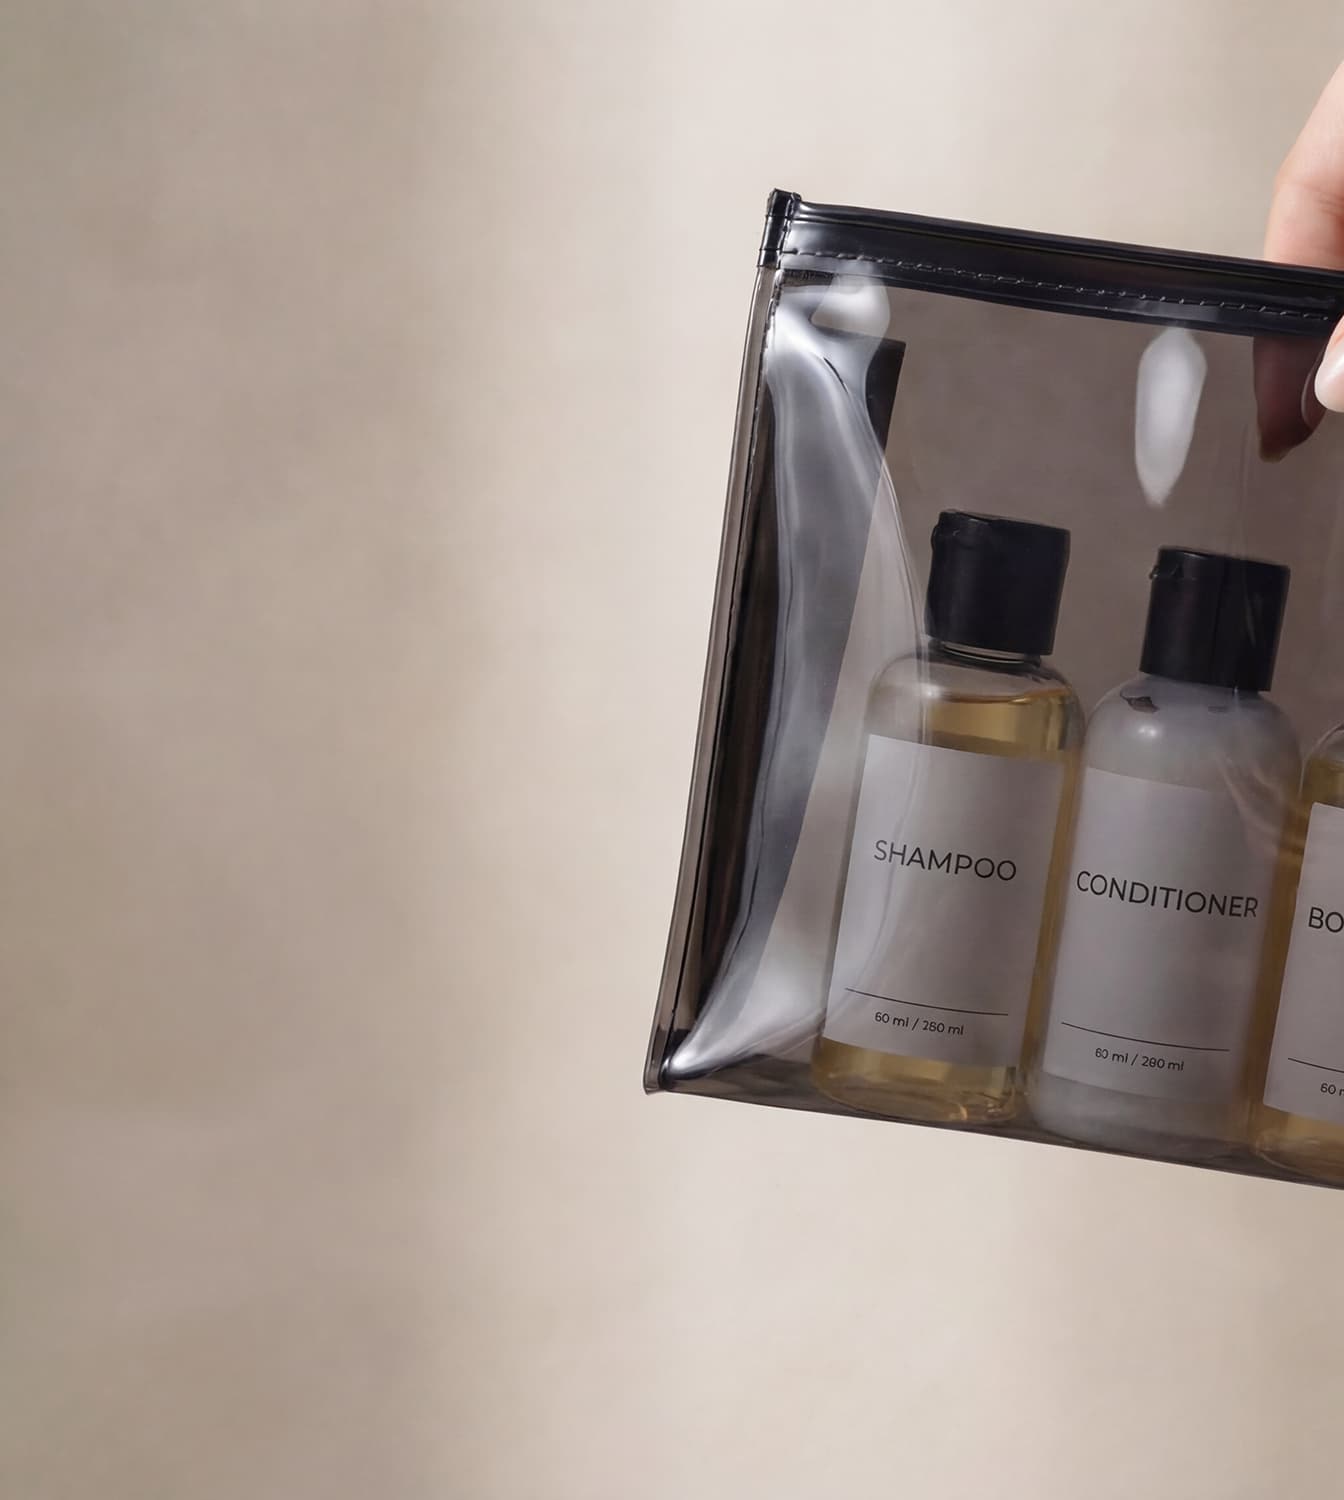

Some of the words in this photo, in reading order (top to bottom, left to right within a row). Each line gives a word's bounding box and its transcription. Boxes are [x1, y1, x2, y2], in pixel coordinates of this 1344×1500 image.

[873, 839, 1017, 881] SHAMPOO
[1076, 870, 1259, 918] CONDITIONER
[874, 1011, 890, 1024] 60
[892, 1016, 910, 1028] ml
[911, 1017, 920, 1031] /
[947, 1024, 965, 1036] ml
[1095, 1047, 1109, 1060] 60
[1111, 1052, 1129, 1064] ml
[1130, 1053, 1139, 1067] /
[1141, 1055, 1165, 1069] 280
[1167, 1060, 1185, 1072] ml
[1319, 1082, 1337, 1095] 60
